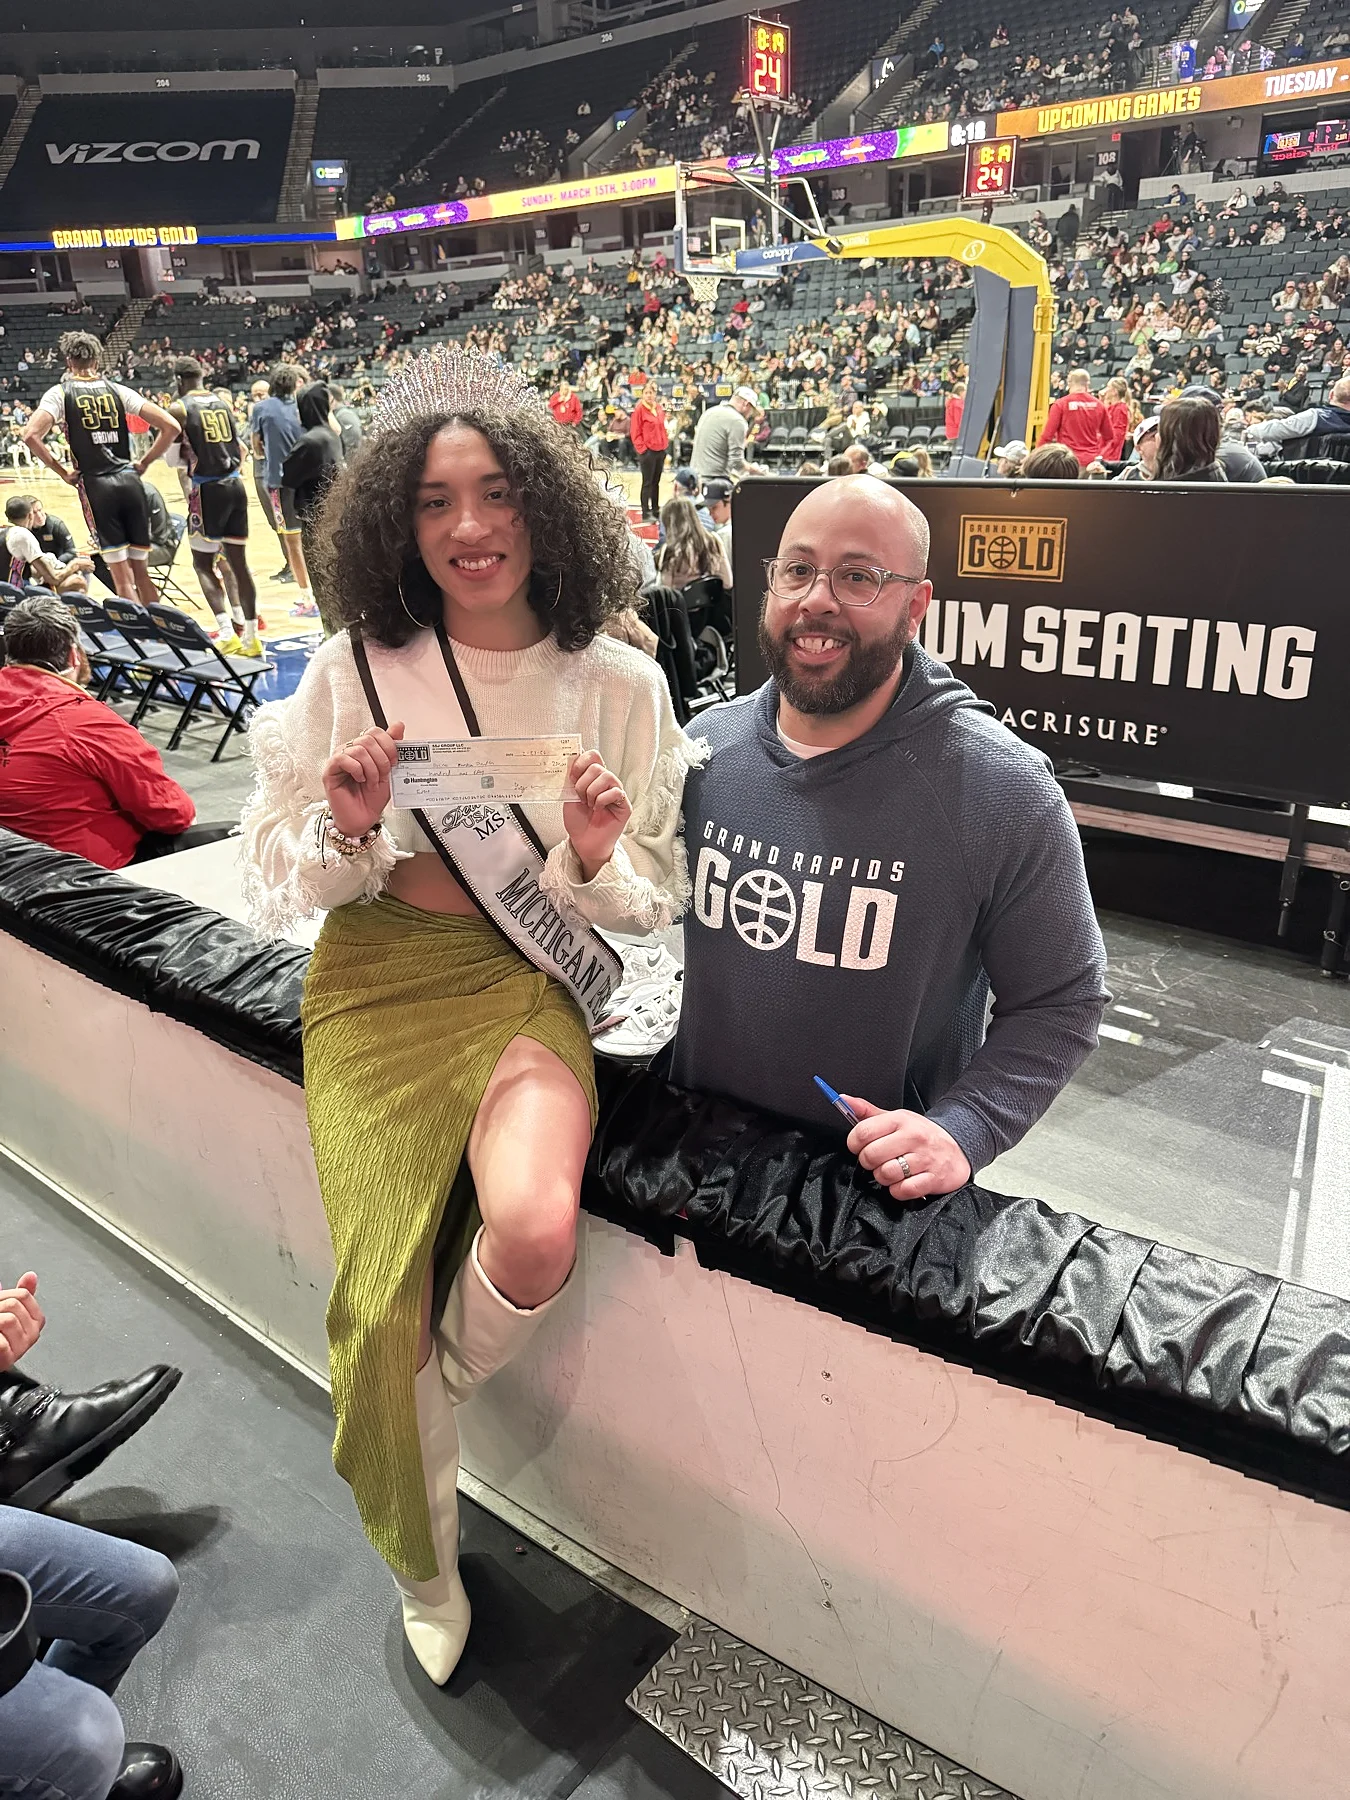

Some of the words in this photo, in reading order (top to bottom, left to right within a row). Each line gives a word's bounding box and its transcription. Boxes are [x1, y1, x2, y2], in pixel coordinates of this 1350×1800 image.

[156, 79, 170, 88] 204
[754, 52, 781, 93] 24
[1265, 67, 1338, 97] TUESDAY
[1037, 97, 1131, 133] UPCOMING
[1133, 86, 1202, 119] GAMES
[1097, 151, 1117, 165] 108
[977, 166, 1004, 191] 24
[560, 188, 591, 201] MARCH
[52, 229, 103, 249] GRAND
[104, 227, 158, 247] RAPIDS
[158, 226, 198, 245] GOLD
[762, 245, 799, 262] canopy
[76, 394, 120, 430] 34
[200, 409, 233, 443] 50
[91, 430, 119, 445] BROWN
[969, 524, 1007, 534] GRAND
[1012, 525, 1057, 536] RAPIDS
[968, 534, 1055, 571] GOLD
[1020, 605, 1317, 700] SEATING
[398, 750, 428, 761] GOLD
[461, 805, 495, 829] USA
[473, 811, 511, 841] MS.
[703, 820, 780, 865] GRAND
[792, 852, 905, 882] RAPIDS
[694, 847, 899, 971] GOLD
[495, 867, 605, 997] MICHIGAN
